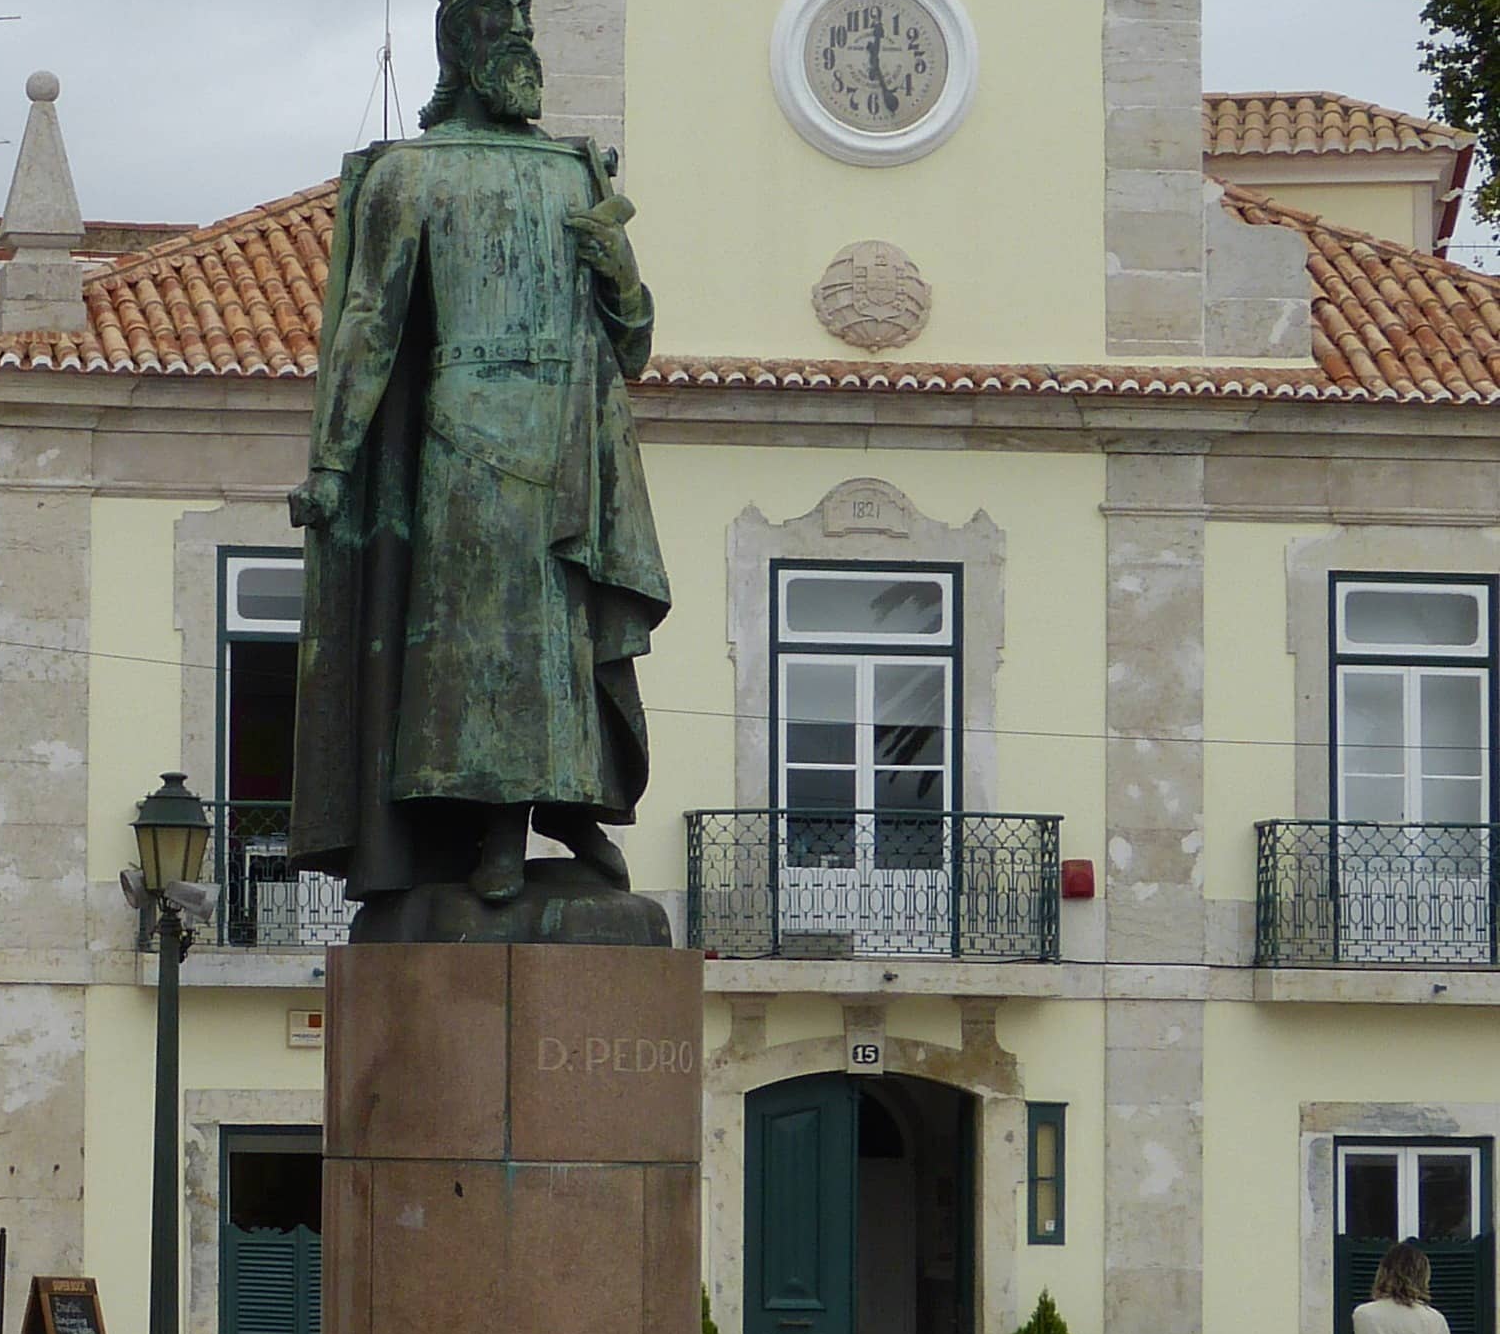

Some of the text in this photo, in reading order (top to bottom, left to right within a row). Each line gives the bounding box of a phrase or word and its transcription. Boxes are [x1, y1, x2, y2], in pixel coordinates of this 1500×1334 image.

[847, 10, 860, 32] 11
[862, 6, 883, 30] 12
[892, 14, 900, 36] 1
[830, 25, 848, 49] 10
[906, 27, 920, 50] 2
[823, 47, 836, 70] 9
[914, 50, 926, 74] 3
[832, 70, 844, 93] 8
[846, 86, 859, 110] 7
[867, 92, 879, 115] 6
[852, 500, 880, 520] 1821
[585, 1037, 693, 1074] PEDRO
[855, 1047, 876, 1062] 15
